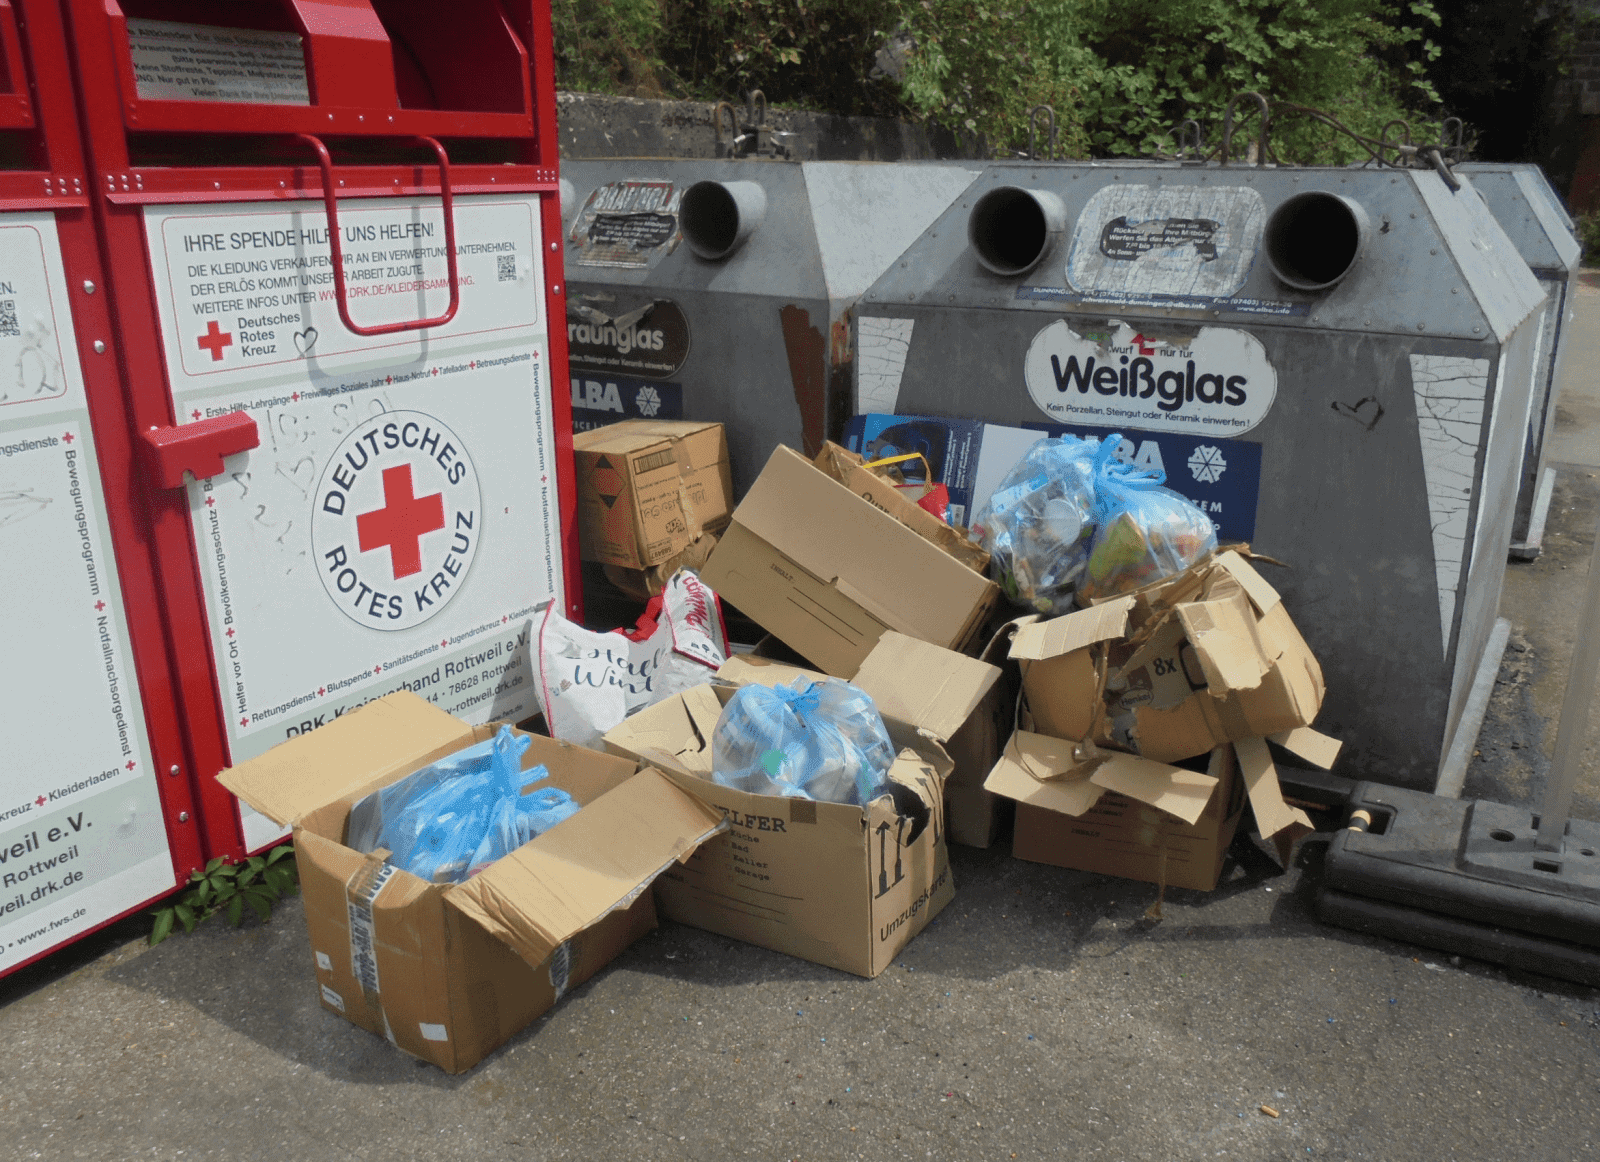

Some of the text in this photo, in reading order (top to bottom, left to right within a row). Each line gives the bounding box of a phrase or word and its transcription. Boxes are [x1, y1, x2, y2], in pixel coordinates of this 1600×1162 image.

[184, 234, 226, 252] IHRE
[230, 230, 296, 250] SPENDE
[346, 225, 376, 242] UNS
[380, 223, 434, 240] HELFEN!
[188, 265, 208, 278] DIE
[211, 260, 268, 276] KLEIDUNG
[270, 255, 333, 271] VERKAUFEN
[356, 252, 370, 264] AN
[372, 251, 387, 263] EIN
[190, 283, 216, 297] DER
[219, 277, 256, 294] ERLÖS
[258, 275, 298, 290] KOMMT
[351, 267, 384, 281] ARBEIT
[386, 264, 425, 278] ZUGUTE.
[193, 299, 243, 315] WEITERE
[247, 295, 279, 309] INFOS
[281, 292, 317, 305] UNTER
[238, 312, 300, 329] Deutsches
[240, 330, 275, 343] Rotes
[241, 344, 276, 357] Kreuz
[1160, 349, 1178, 357] nur
[206, 395, 291, 418] Erste-Hilfe-Lehrgänge
[300, 386, 340, 401] Freiwilliges
[340, 381, 369, 394] Soziales
[369, 378, 385, 388] Jahr
[393, 369, 431, 384] Haus-Notruf
[476, 353, 531, 369] Betreuungsdienste
[1050, 354, 1248, 412] Weißglas
[533, 363, 545, 471] Bewegungsprogramm
[1046, 402, 1065, 412] Kein
[1066, 404, 1105, 416] Porzellan,
[1106, 407, 1141, 420] Steingut
[1143, 410, 1162, 420] oder
[1165, 411, 1200, 423] Keramik
[323, 422, 466, 515] DEUTSCHES
[65, 449, 100, 596] Bewegungsprogramm
[541, 486, 554, 593] Notfallnachsorgedienst
[208, 509, 233, 625] Bevölkerungsschutz
[325, 510, 473, 619] ROTES KREUZ
[251, 690, 317, 723] Rettungsdienst
[327, 670, 373, 693] Blutspende
[383, 643, 439, 672] Sanitätsdienste
[449, 619, 500, 646] Jugendrotkreuz
[445, 642, 503, 678] Rottweil
[506, 632, 531, 652] e.V.
[1153, 657, 1177, 676] 8x
[97, 616, 132, 756] Notfallnachsorgedienst
[229, 640, 247, 714] Helfer vor Ort
[449, 675, 479, 697] 78628
[482, 656, 522, 682] Rottweil
[48, 767, 120, 802] Kleiderladen
[47, 811, 93, 843] e.V.
[731, 841, 749, 853] Bad
[734, 854, 768, 868] Keller
[3, 845, 79, 889] Rottweil
[735, 866, 770, 881] Garage
[17, 907, 87, 946] www.fws.de
